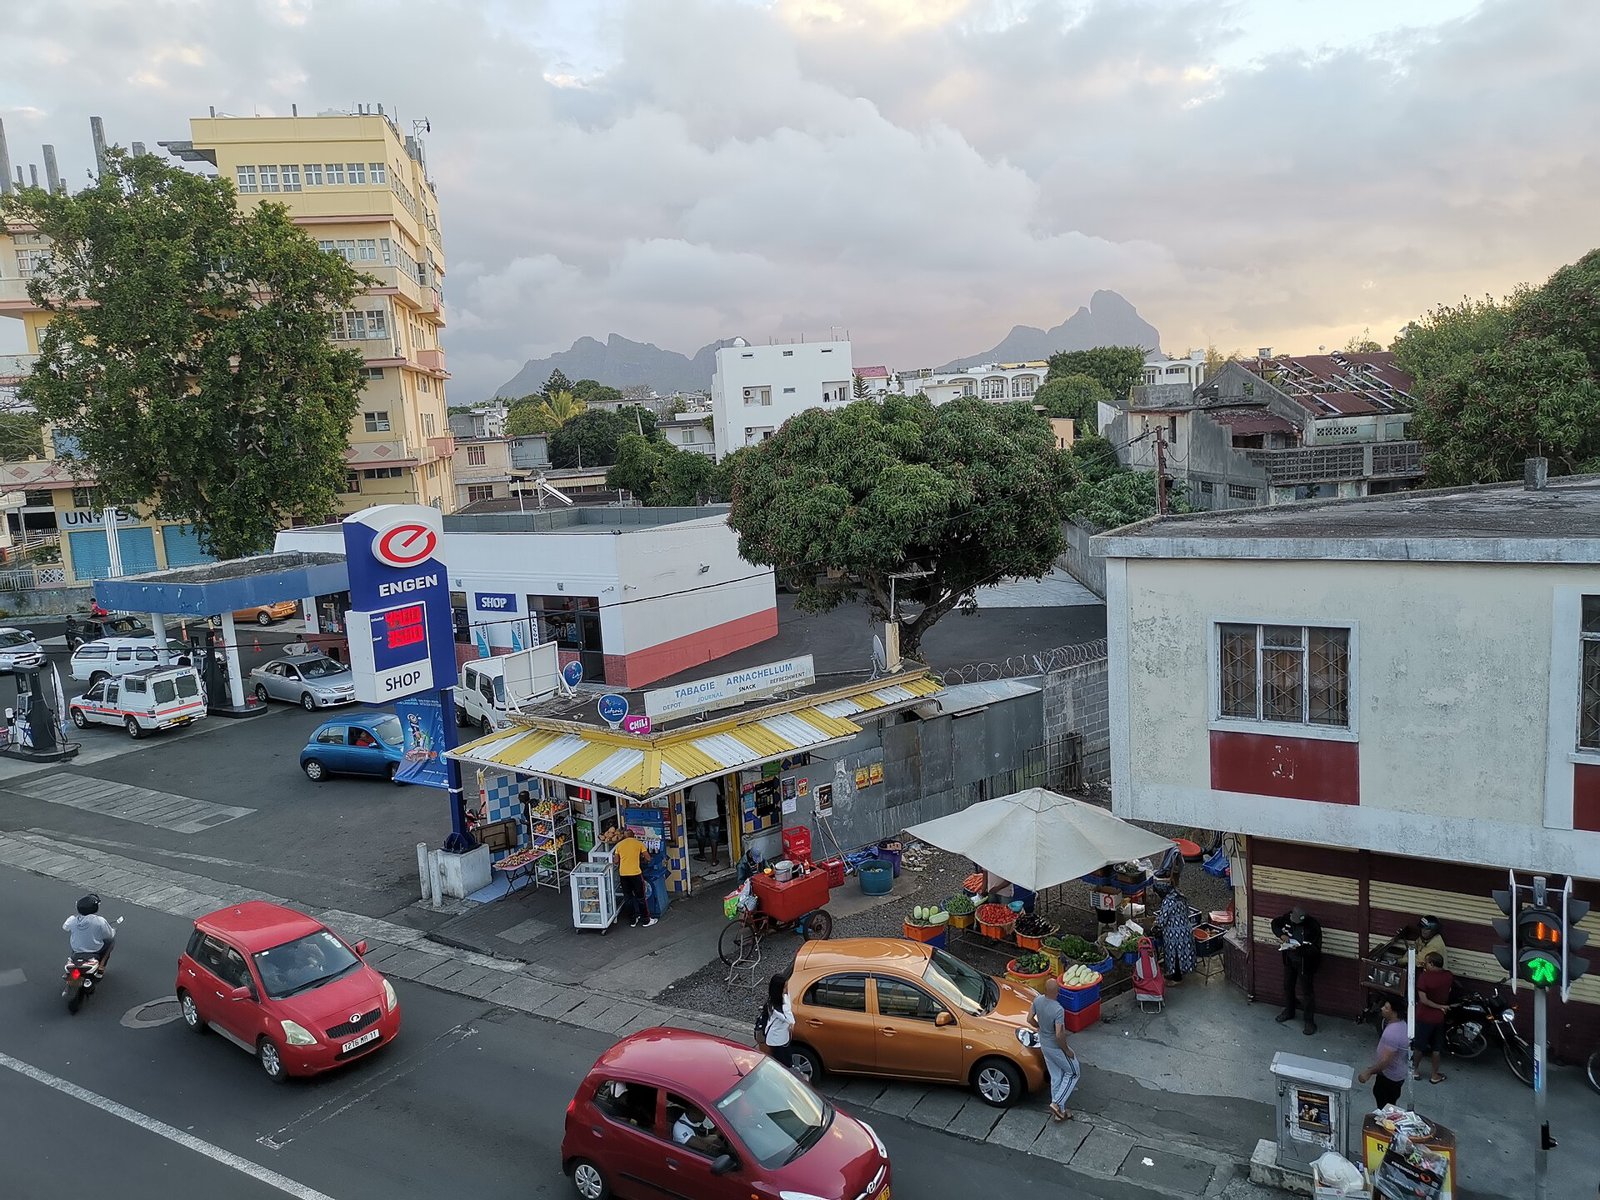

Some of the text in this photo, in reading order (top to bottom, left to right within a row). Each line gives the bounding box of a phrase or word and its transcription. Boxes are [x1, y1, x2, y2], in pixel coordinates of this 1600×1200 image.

[379, 574, 438, 597] ENGEN
[481, 596, 507, 608] SHOP
[385, 670, 421, 692] SHOP
[662, 702, 682, 711] DEPOT
[697, 692, 723, 703] JOURNAL
[738, 684, 757, 692] SNACK
[769, 672, 805, 684] REFRESHMENT
[675, 682, 715, 698] TABAGIE
[726, 663, 793, 686] ARNACHELLUM
